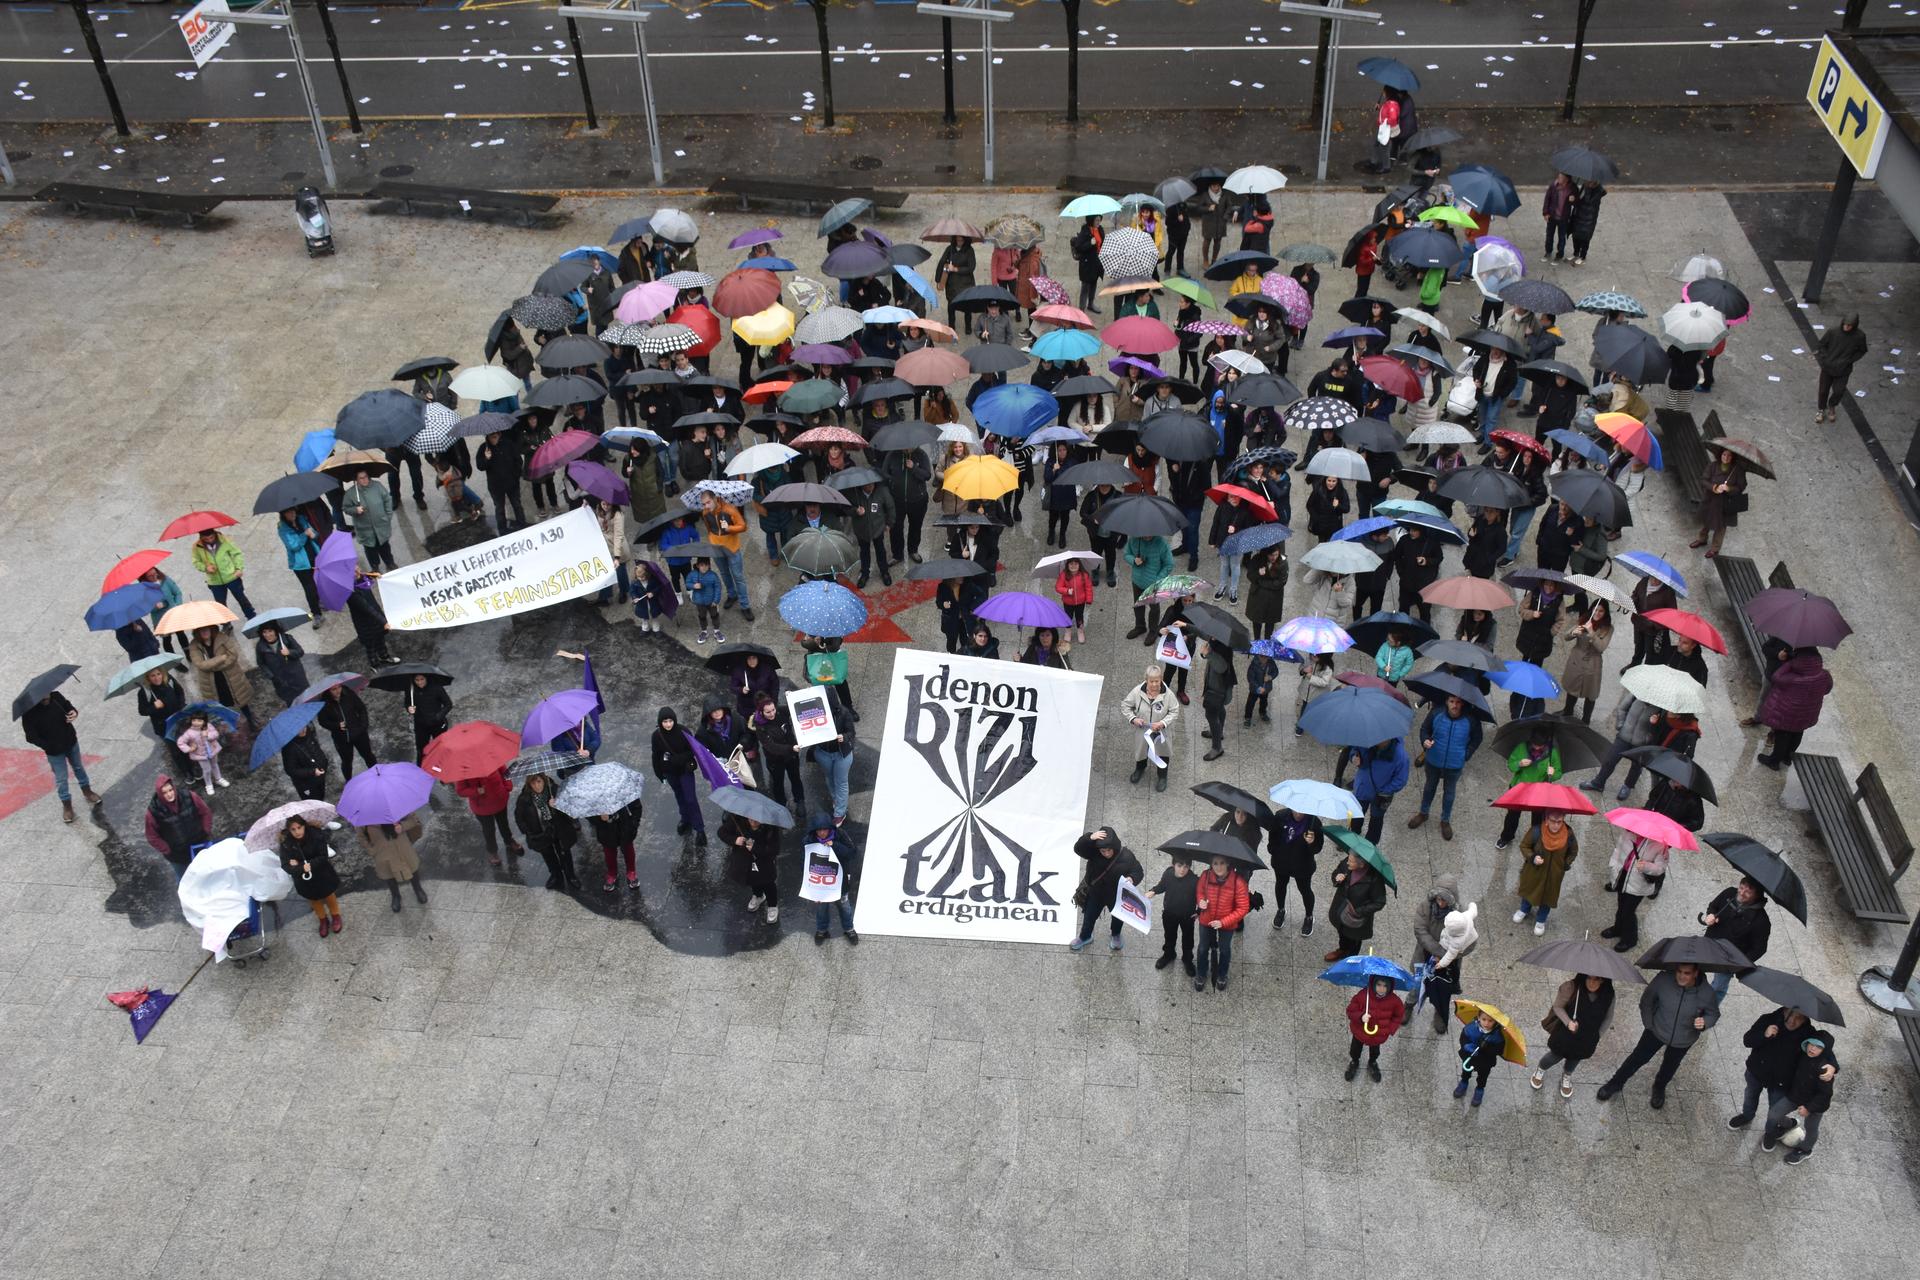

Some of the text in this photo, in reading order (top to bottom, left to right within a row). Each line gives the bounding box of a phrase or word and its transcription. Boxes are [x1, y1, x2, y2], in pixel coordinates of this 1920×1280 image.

[1820, 66, 1838, 100] P
[412, 562, 461, 590] KALEAK
[540, 526, 565, 545] A30
[474, 557, 608, 614] FEMINISTARA
[925, 664, 1039, 713] denon
[800, 716, 828, 731] 30
[903, 674, 1039, 808] bizi
[808, 874, 837, 885] 30
[899, 808, 1061, 906] tzak
[898, 897, 1060, 924] erdigunean
